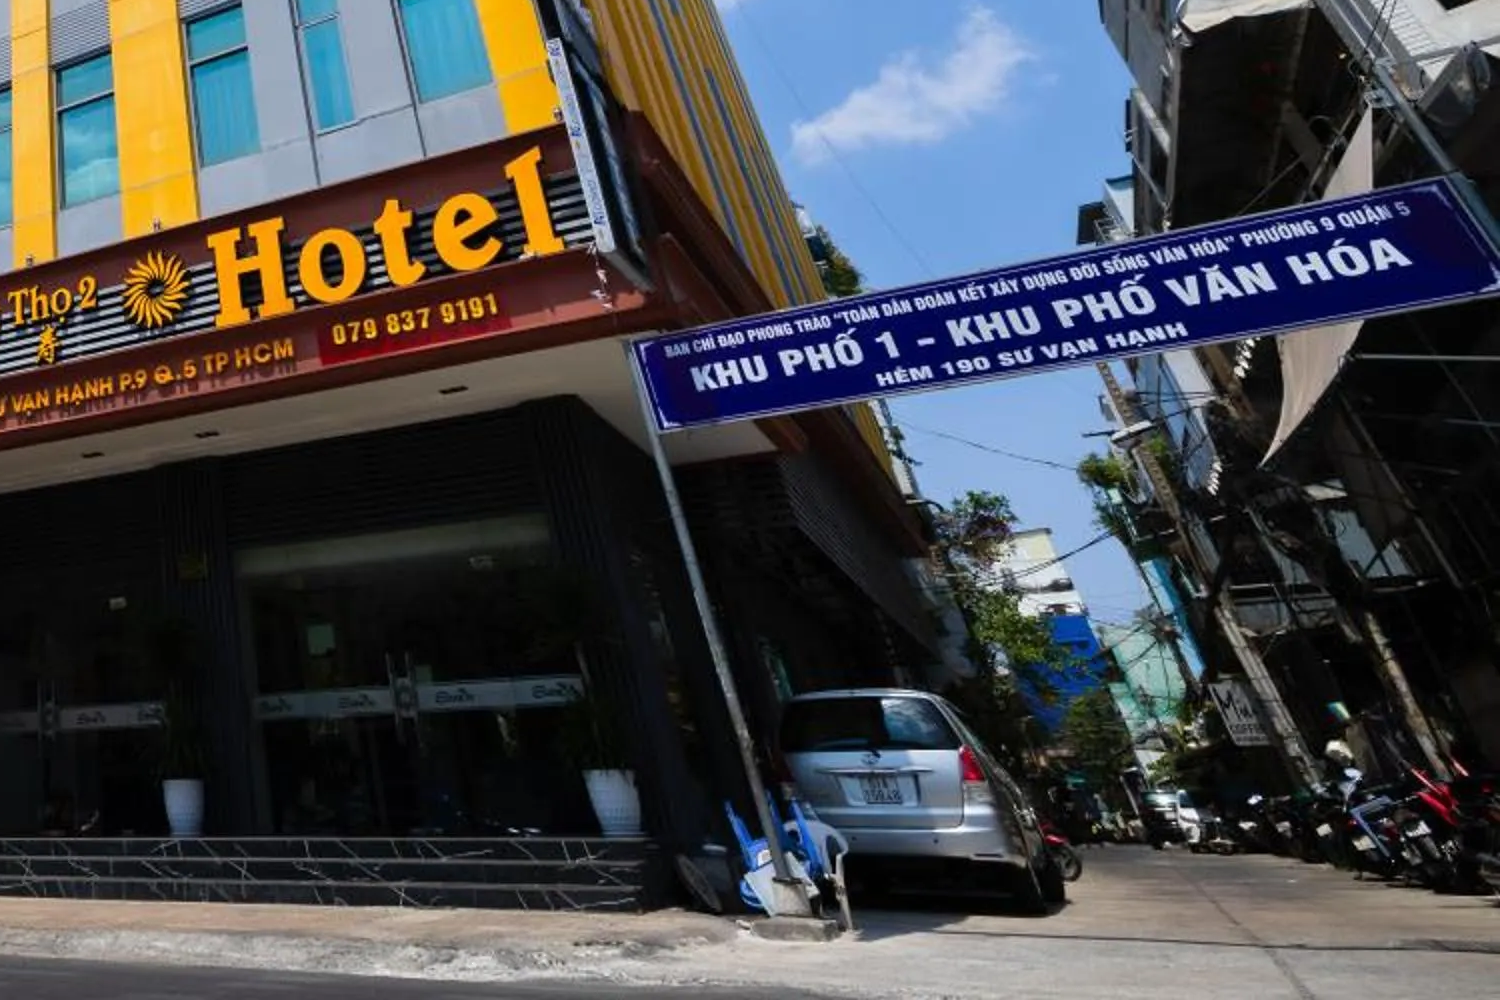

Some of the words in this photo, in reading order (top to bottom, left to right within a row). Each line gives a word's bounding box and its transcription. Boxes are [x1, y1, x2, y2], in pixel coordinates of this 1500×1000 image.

[207, 145, 565, 330] Hotel
[7, 284, 72, 325] Thọ
[78, 275, 99, 310] 2
[664, 341, 691, 358] BAN
[717, 331, 745, 349] ĐẠO
[747, 322, 794, 342] PHONG
[794, 313, 831, 333] TRÀO
[914, 290, 957, 310] ĐOÀN
[958, 281, 988, 302] KẾT
[989, 278, 1020, 297] XÂY
[1022, 269, 1068, 290] DỰNG
[1069, 261, 1101, 281] ĐỜI
[1101, 252, 1149, 275] SỐNG
[1150, 245, 1188, 265] VĂN
[1239, 218, 1319, 248] PHƯỜNG
[1320, 216, 1336, 232] 9
[1337, 204, 1393, 230] QUẬN
[1395, 201, 1411, 217] 5
[689, 354, 769, 392] KHU
[778, 328, 864, 377] PHỐ
[875, 331, 900, 358] 1
[917, 336, 936, 347] -
[946, 305, 1042, 347] KHU
[1051, 273, 1157, 329] PHỐ
[1164, 262, 1278, 307] VĂN
[1286, 237, 1414, 286] HÓA
[332, 318, 378, 347] 079
[387, 305, 430, 335] 837
[441, 293, 499, 325] 9191
[941, 356, 990, 376] 190
[997, 346, 1034, 368] SƯ
[1040, 337, 1099, 360] VẠN
[1106, 321, 1189, 349] HẠNH
[11, 389, 49, 417] VẠN
[55, 376, 114, 405] HẠNH
[119, 368, 148, 392] P.9
[153, 360, 197, 385] Q.5
[203, 352, 229, 375] TP
[235, 337, 294, 369] HCM
